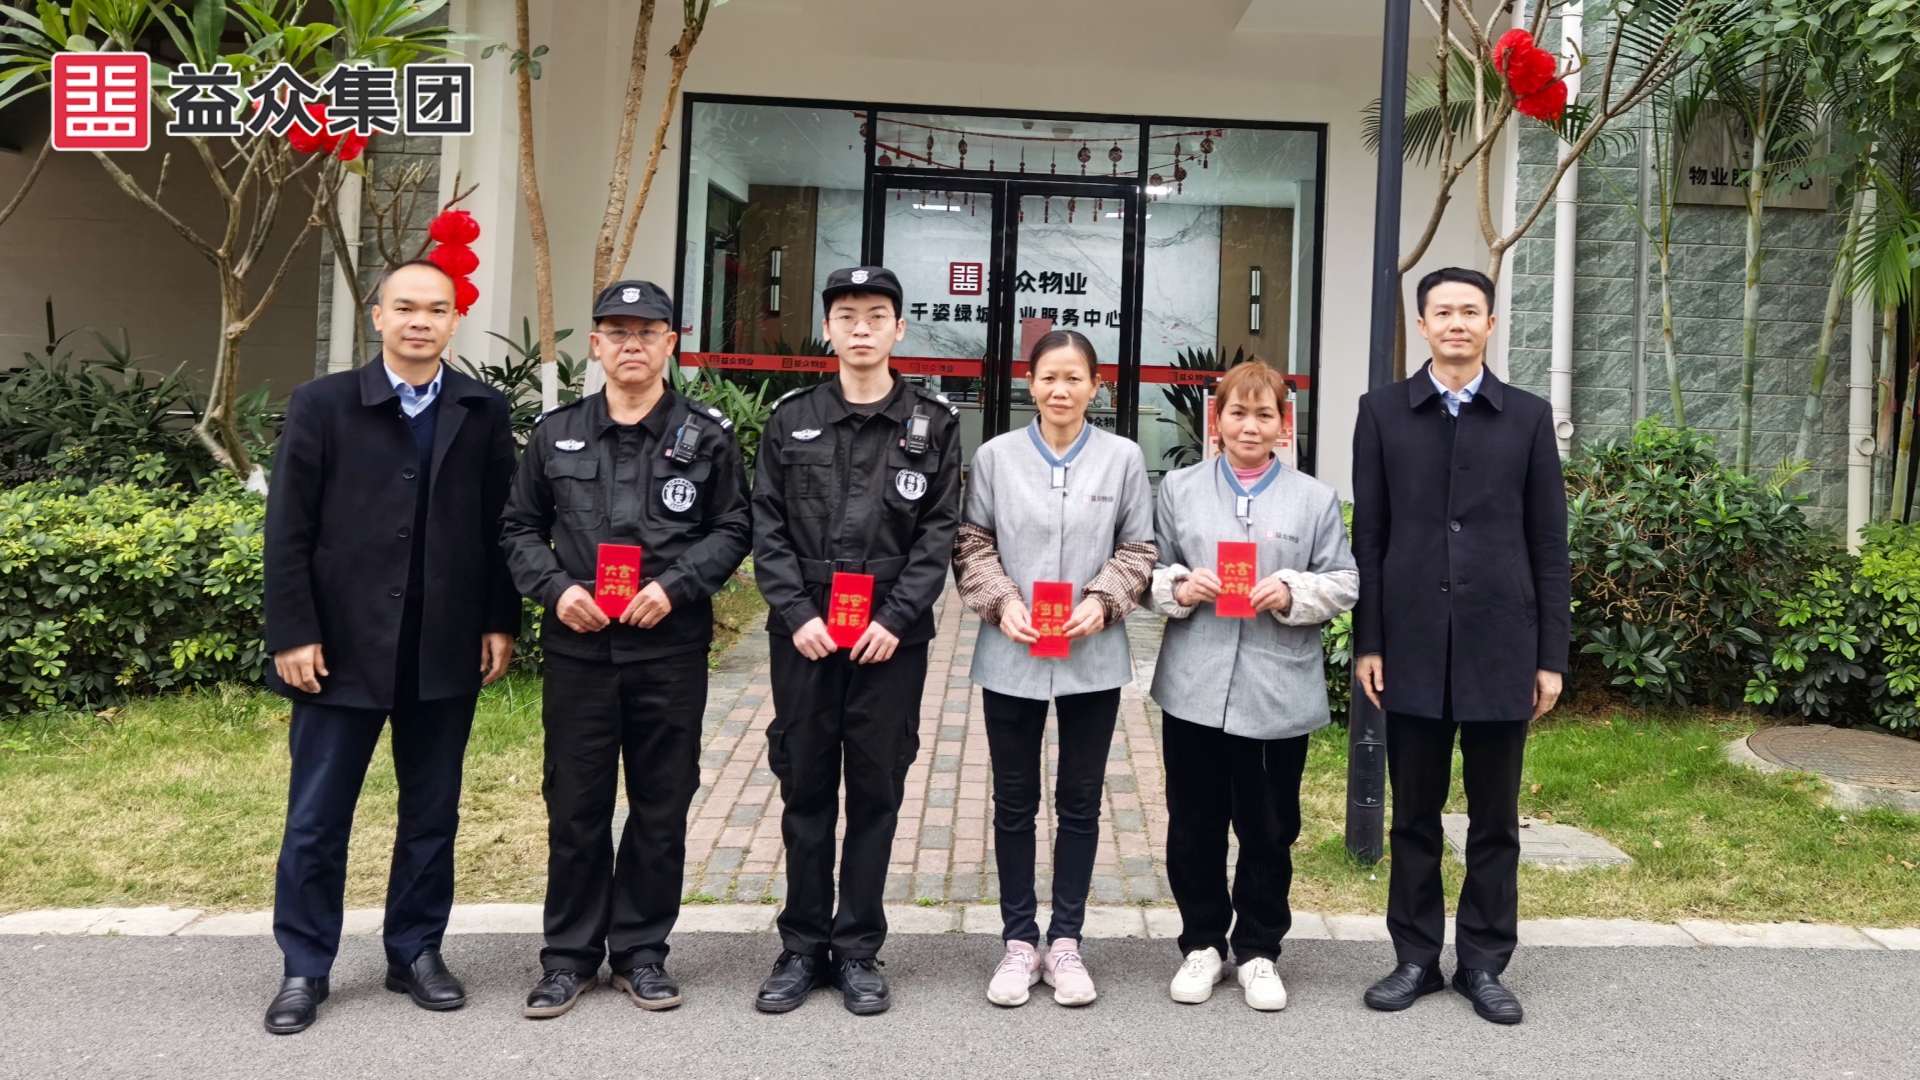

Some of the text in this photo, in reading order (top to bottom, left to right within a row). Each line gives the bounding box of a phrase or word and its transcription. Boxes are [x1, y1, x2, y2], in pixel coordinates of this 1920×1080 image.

[988, 270, 1087, 295] 众物业
[910, 303, 1121, 328] 千姿绿城业服务中心
[1094, 416, 1116, 428] 众物
